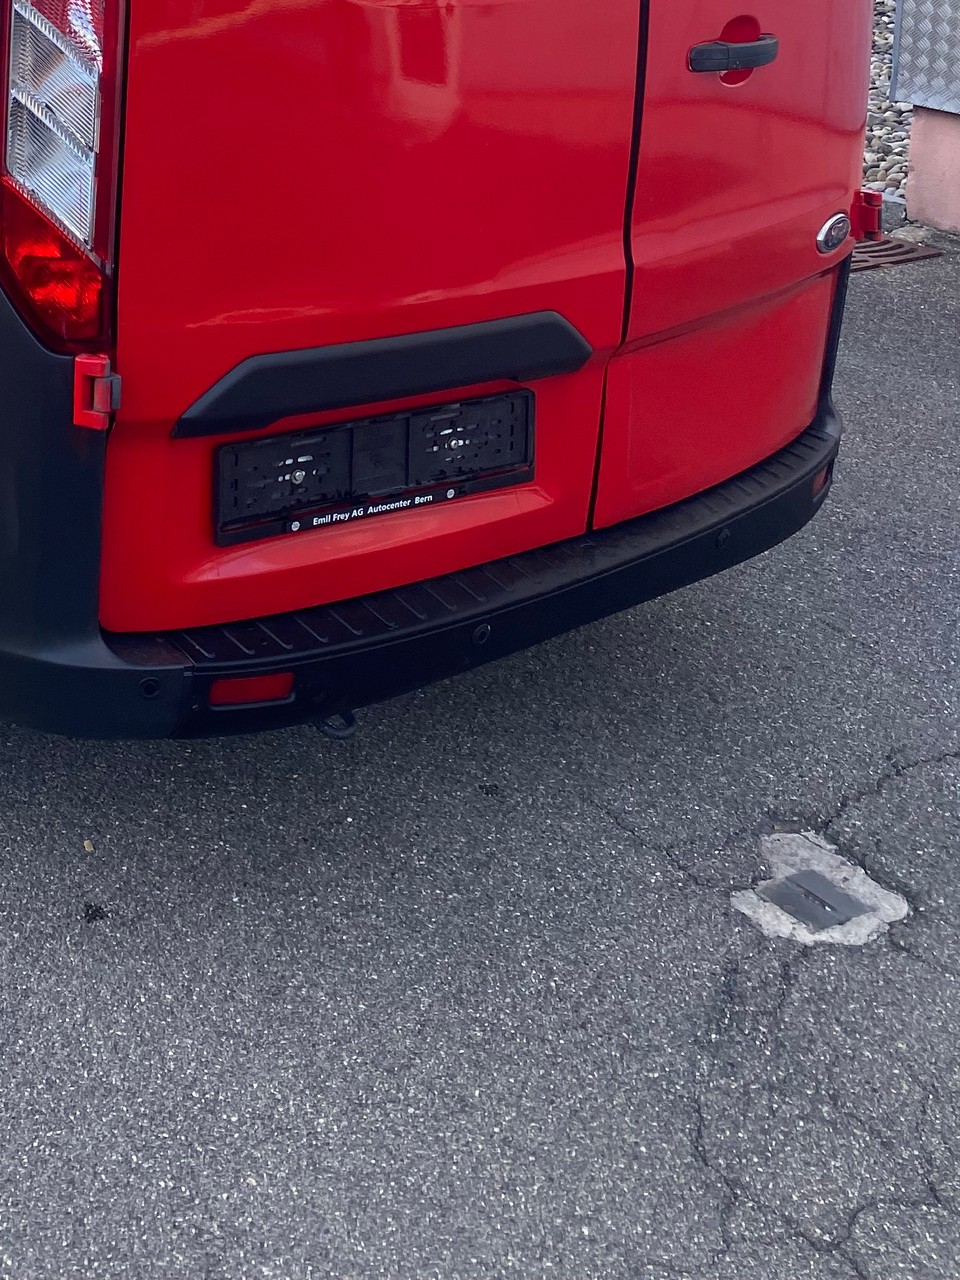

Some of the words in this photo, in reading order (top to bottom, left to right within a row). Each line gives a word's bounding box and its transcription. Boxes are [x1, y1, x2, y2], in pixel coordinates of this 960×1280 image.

[312, 514, 331, 526] Emil
[332, 511, 350, 522] Frey
[351, 507, 364, 518] AG
[367, 499, 411, 515] Autocenter
[414, 494, 433, 505] Bern
